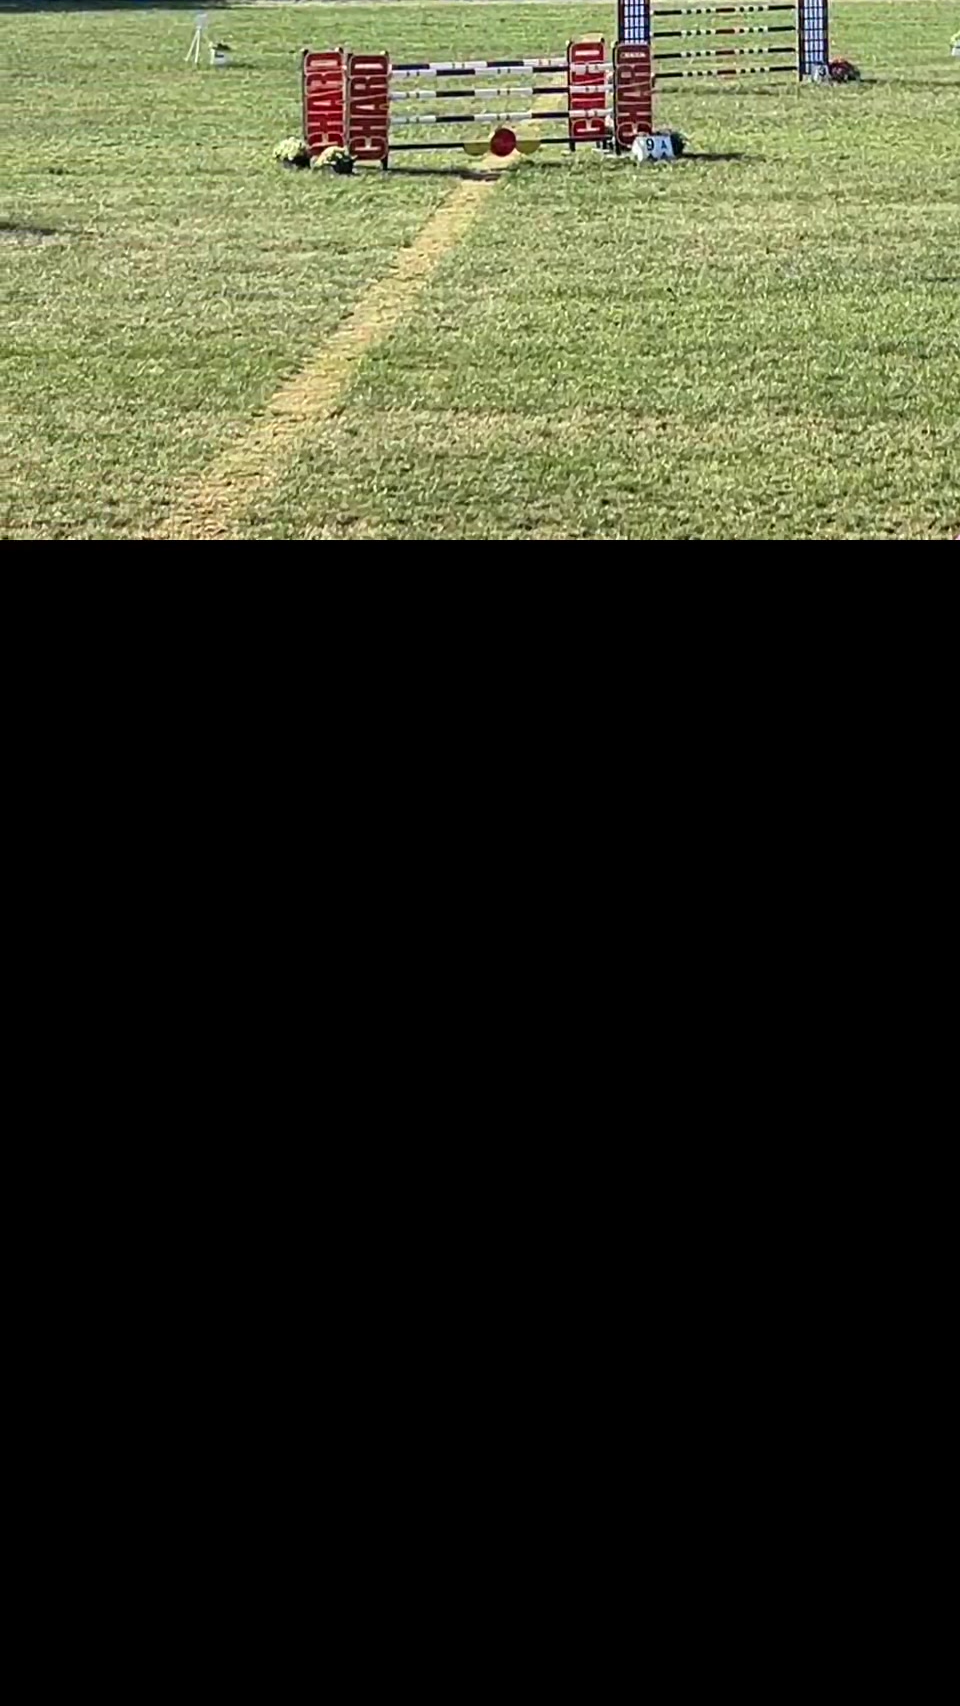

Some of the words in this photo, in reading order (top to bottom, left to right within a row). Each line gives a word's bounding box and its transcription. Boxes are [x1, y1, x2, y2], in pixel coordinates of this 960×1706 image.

[304, 52, 345, 159] CHARD
[348, 54, 389, 160] CHARD
[616, 43, 651, 148] CHARD
[646, 138, 655, 151] 9
